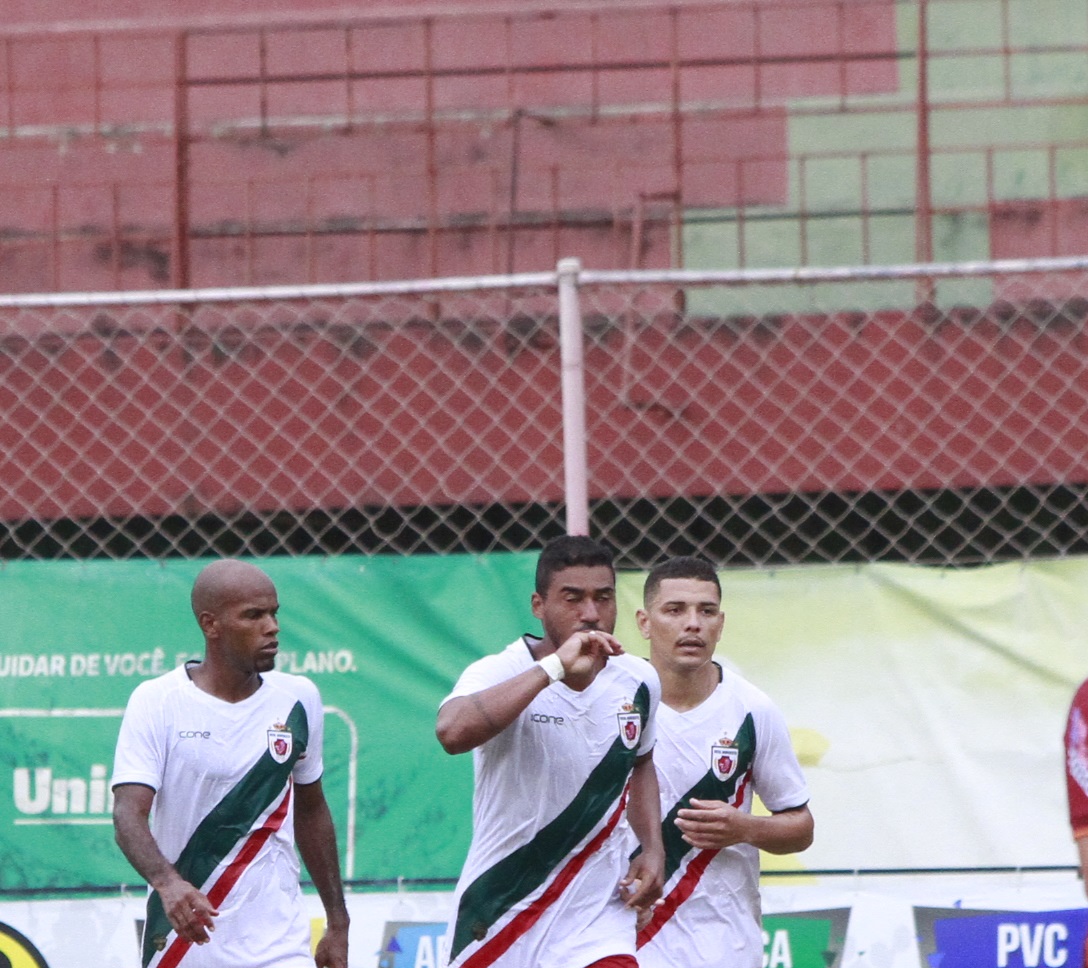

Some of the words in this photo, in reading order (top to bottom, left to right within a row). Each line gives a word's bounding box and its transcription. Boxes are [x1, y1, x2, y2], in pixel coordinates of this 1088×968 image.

[69, 654, 100, 677] DE
[13, 764, 114, 815] Uni
[997, 923, 1069, 968] PVC
